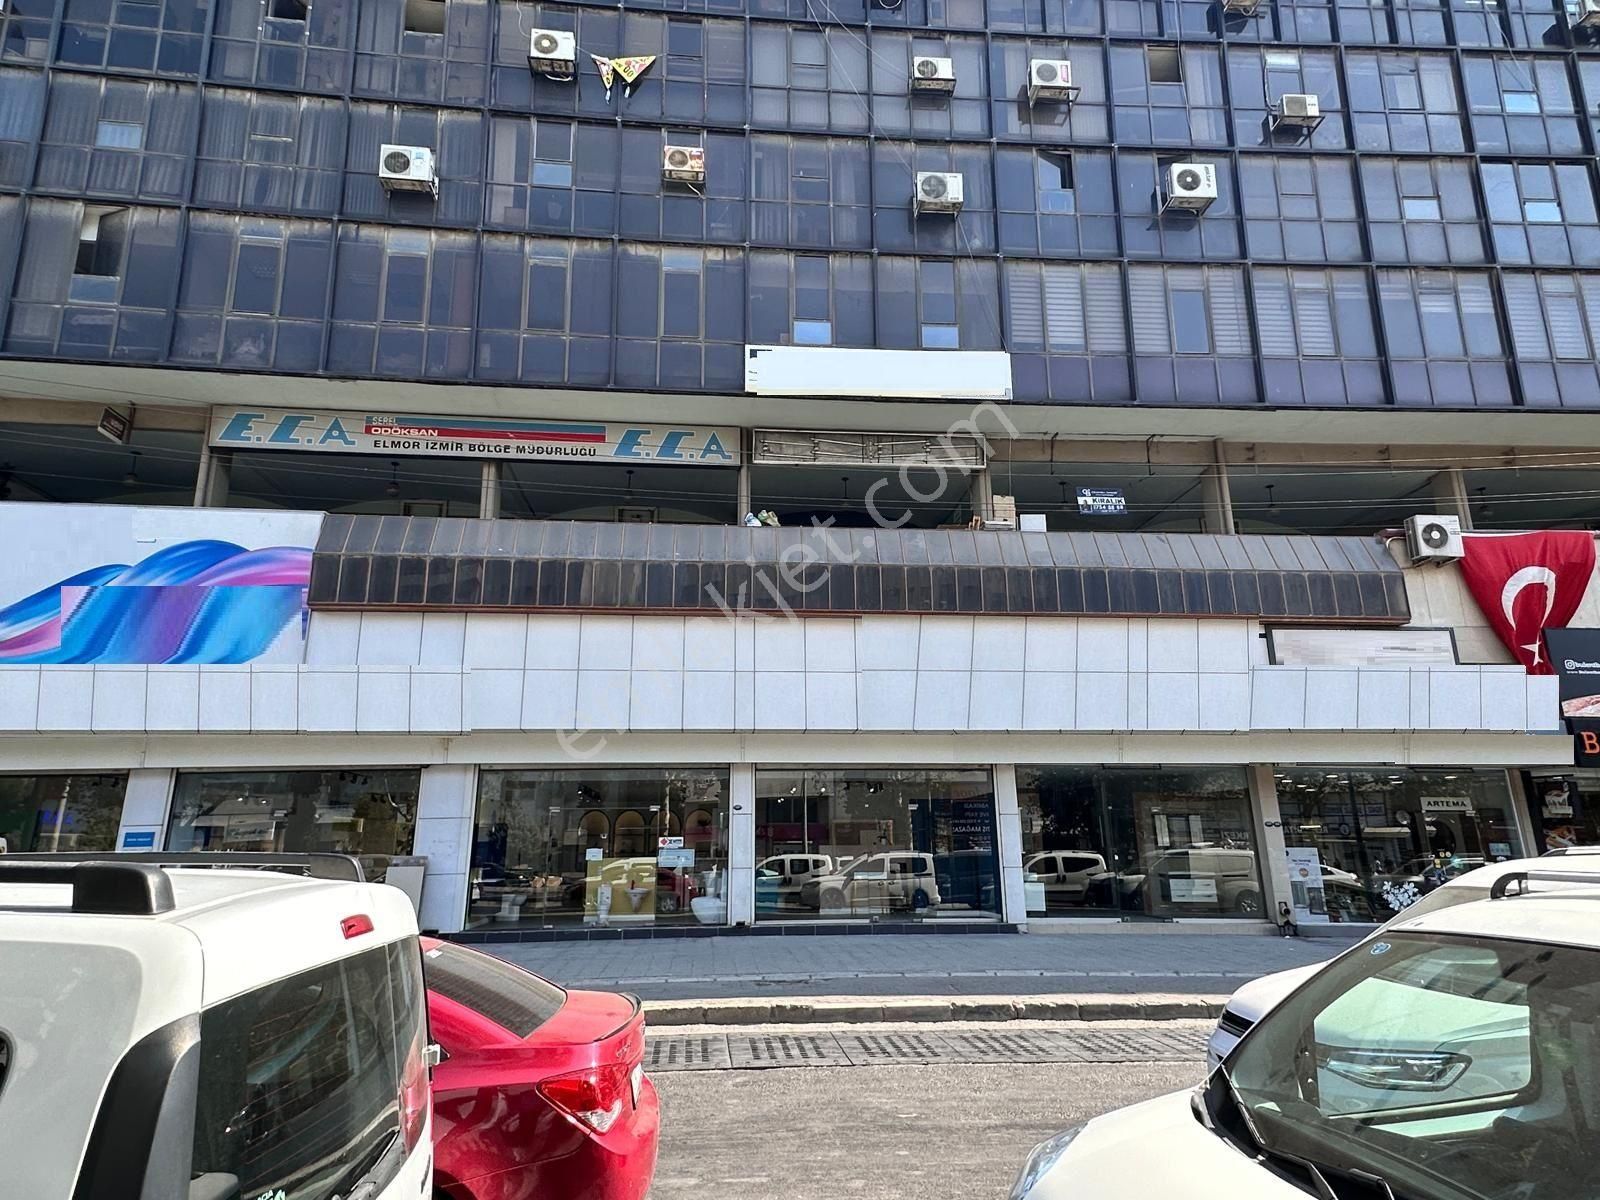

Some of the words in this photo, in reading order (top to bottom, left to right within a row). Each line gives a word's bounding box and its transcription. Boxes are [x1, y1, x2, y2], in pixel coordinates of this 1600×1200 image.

[371, 427, 438, 437] ODÖKSAN
[373, 440, 421, 450] ELMOR
[468, 442, 511, 454] BÖLGE
